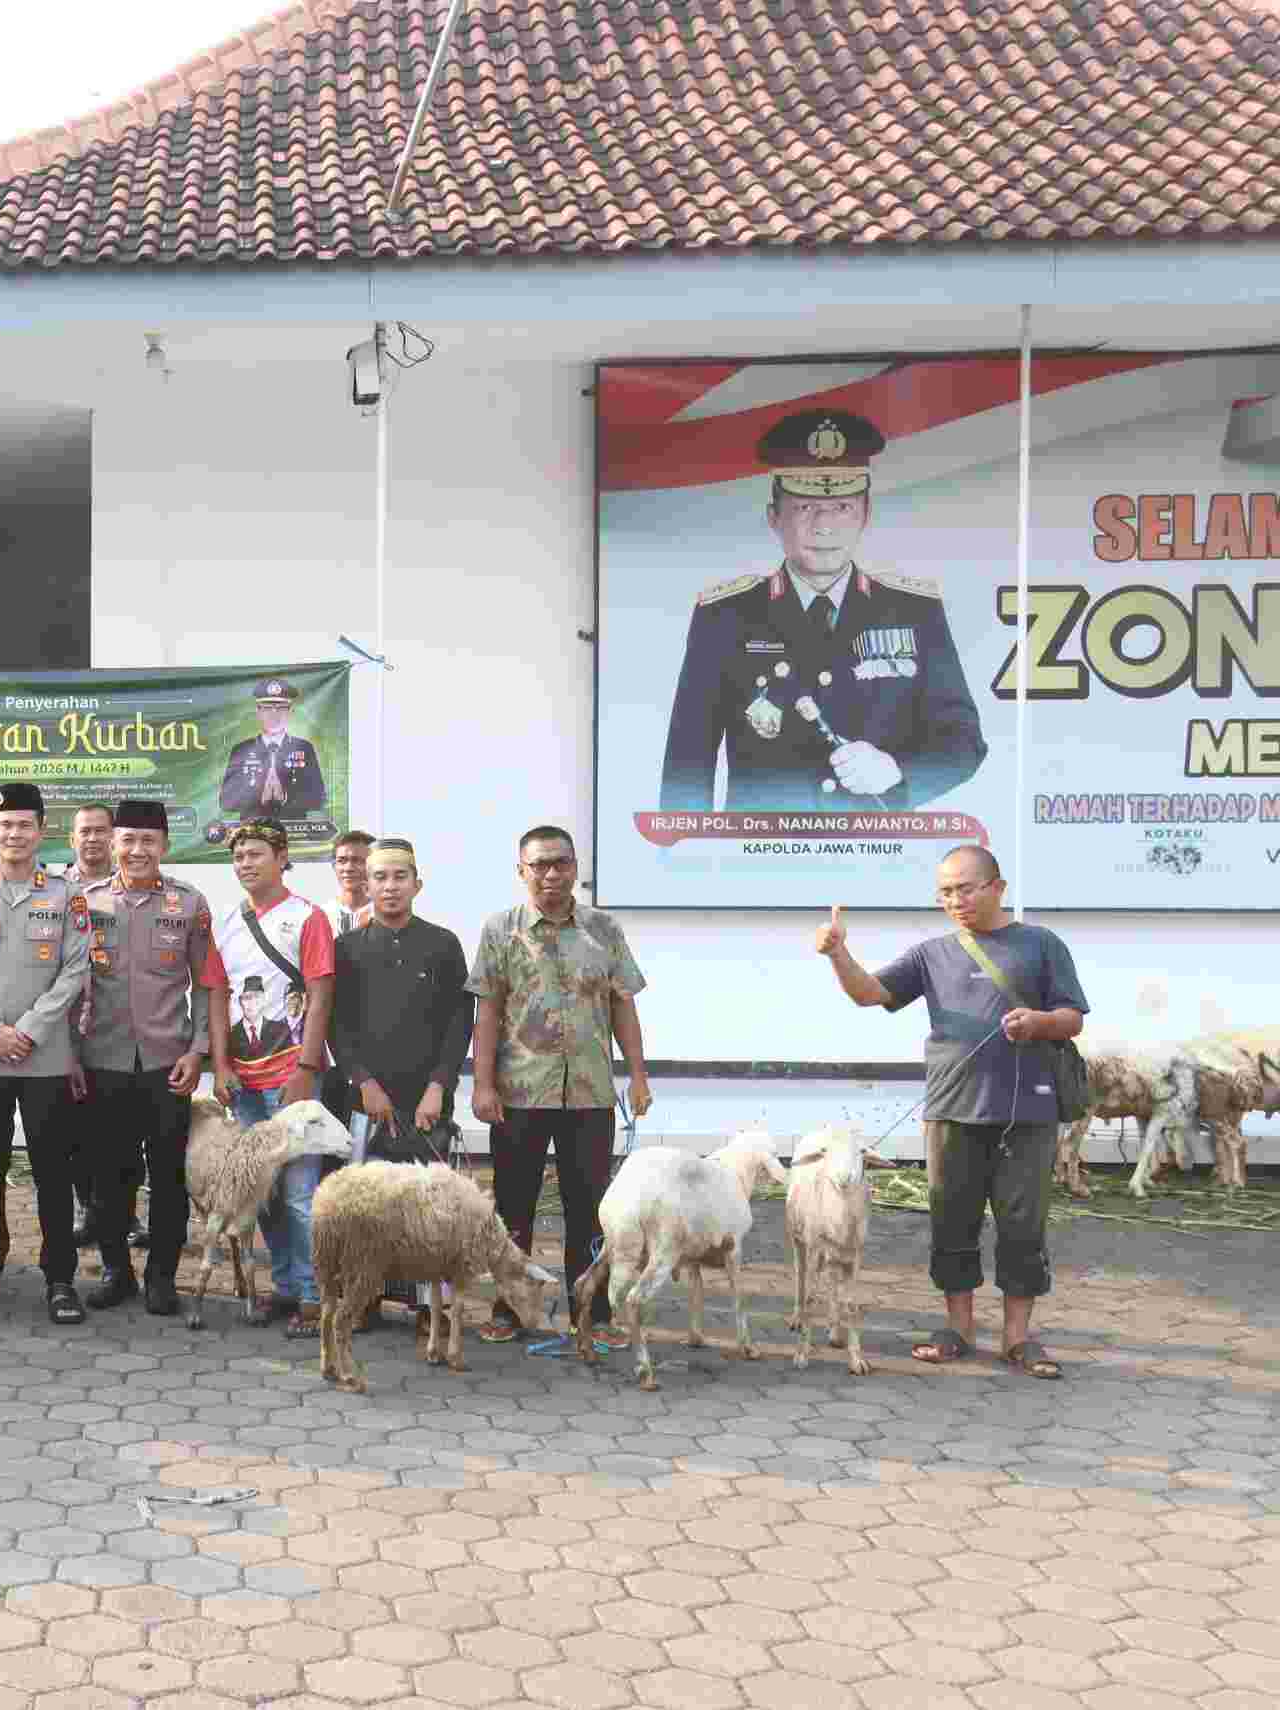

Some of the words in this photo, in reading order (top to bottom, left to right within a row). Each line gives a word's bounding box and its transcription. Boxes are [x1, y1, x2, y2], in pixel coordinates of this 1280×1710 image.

[990, 584, 1280, 699] ZON
[5, 696, 99, 712] Penyerahan
[59, 711, 208, 754] Kurban
[1184, 718, 1280, 777] ME
[32, 763, 63, 775] 2026
[1032, 793, 1124, 824] RAMAH
[1127, 793, 1257, 823] TERHADAP
[650, 817, 697, 831] IRJEN
[702, 817, 739, 831] POL.
[743, 817, 773, 831] Drs.
[778, 817, 849, 831] NANANG
[743, 843, 812, 855] KAPOLDA
[815, 843, 856, 855] JAWA
[858, 843, 903, 855] TIMUR
[28, 911, 64, 921] POLRI
[155, 918, 187, 929] POLRI
